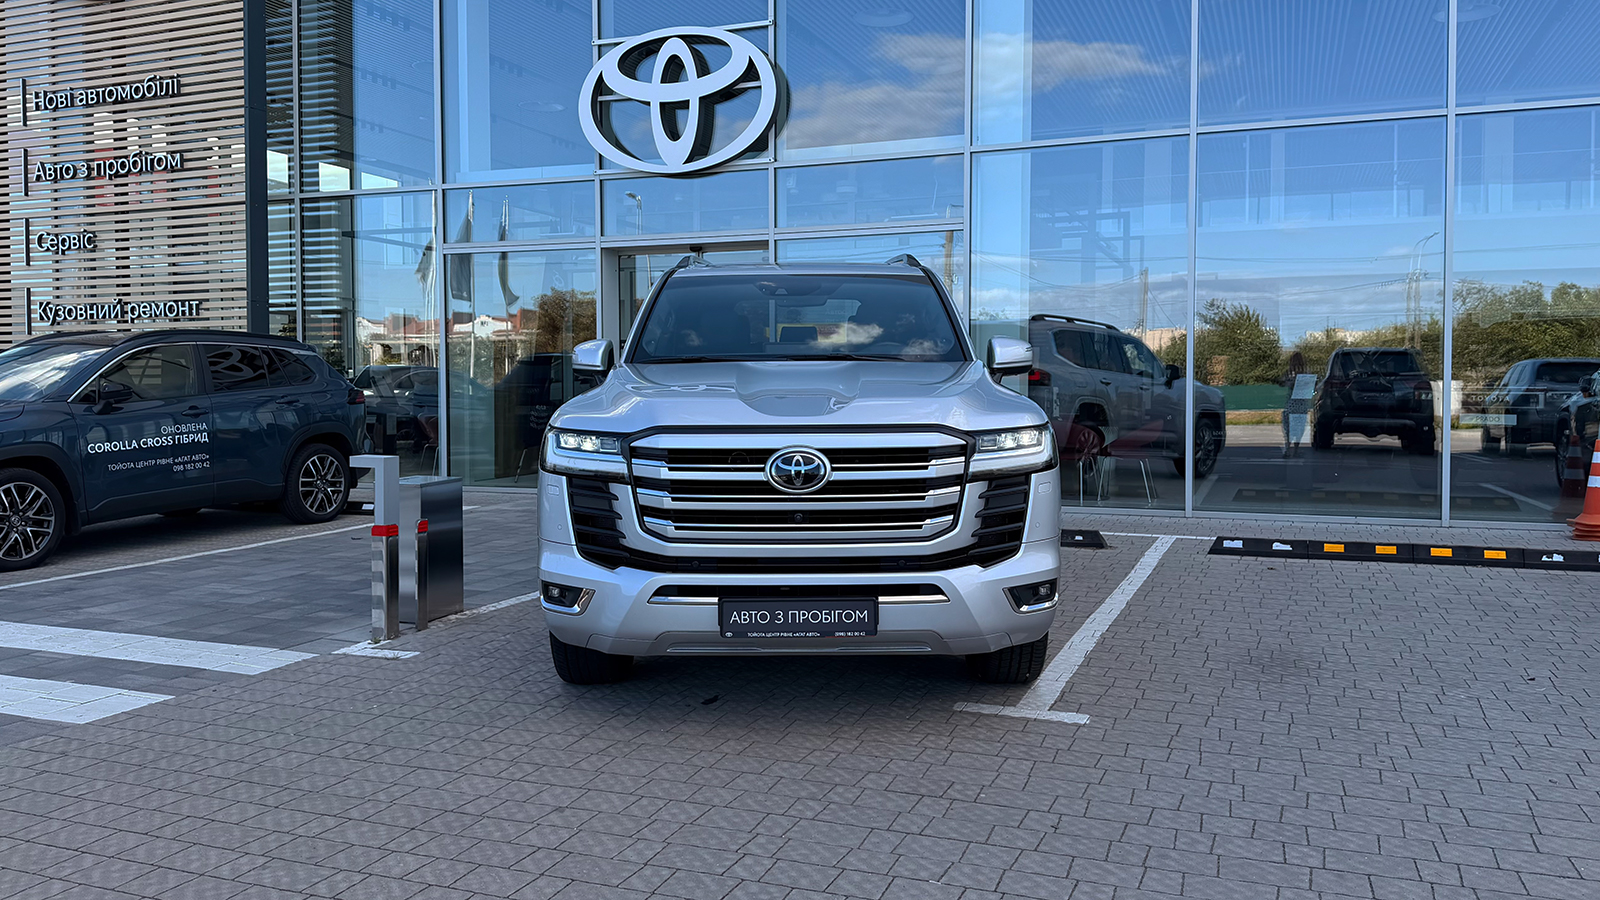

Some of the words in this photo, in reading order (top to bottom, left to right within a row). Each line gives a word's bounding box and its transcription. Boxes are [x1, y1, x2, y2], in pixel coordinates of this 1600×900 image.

[32, 86, 73, 111] Нові
[77, 73, 181, 106] автомобілі
[34, 161, 76, 182] Авто
[79, 161, 90, 178] з
[94, 150, 183, 180] пробігом
[35, 228, 97, 255] Сервіс
[37, 298, 124, 326] Кузовний
[127, 299, 200, 323] ремонт
[161, 422, 208, 434] ОНОВЛЕНА
[88, 440, 138, 454] COROLLA
[140, 436, 173, 449] CROSS
[175, 432, 209, 445] ГІБРИД
[108, 462, 134, 470] ТОЙОТА
[136, 459, 156, 469] ЦЕНТР
[156, 457, 174, 466] РІВНЕ
[174, 455, 191, 463] «АГАТ
[192, 453, 210, 462] АВТО»
[729, 610, 771, 624] АВТО
[774, 610, 784, 624] З
[788, 610, 868, 624] ПРОБІГОМ
